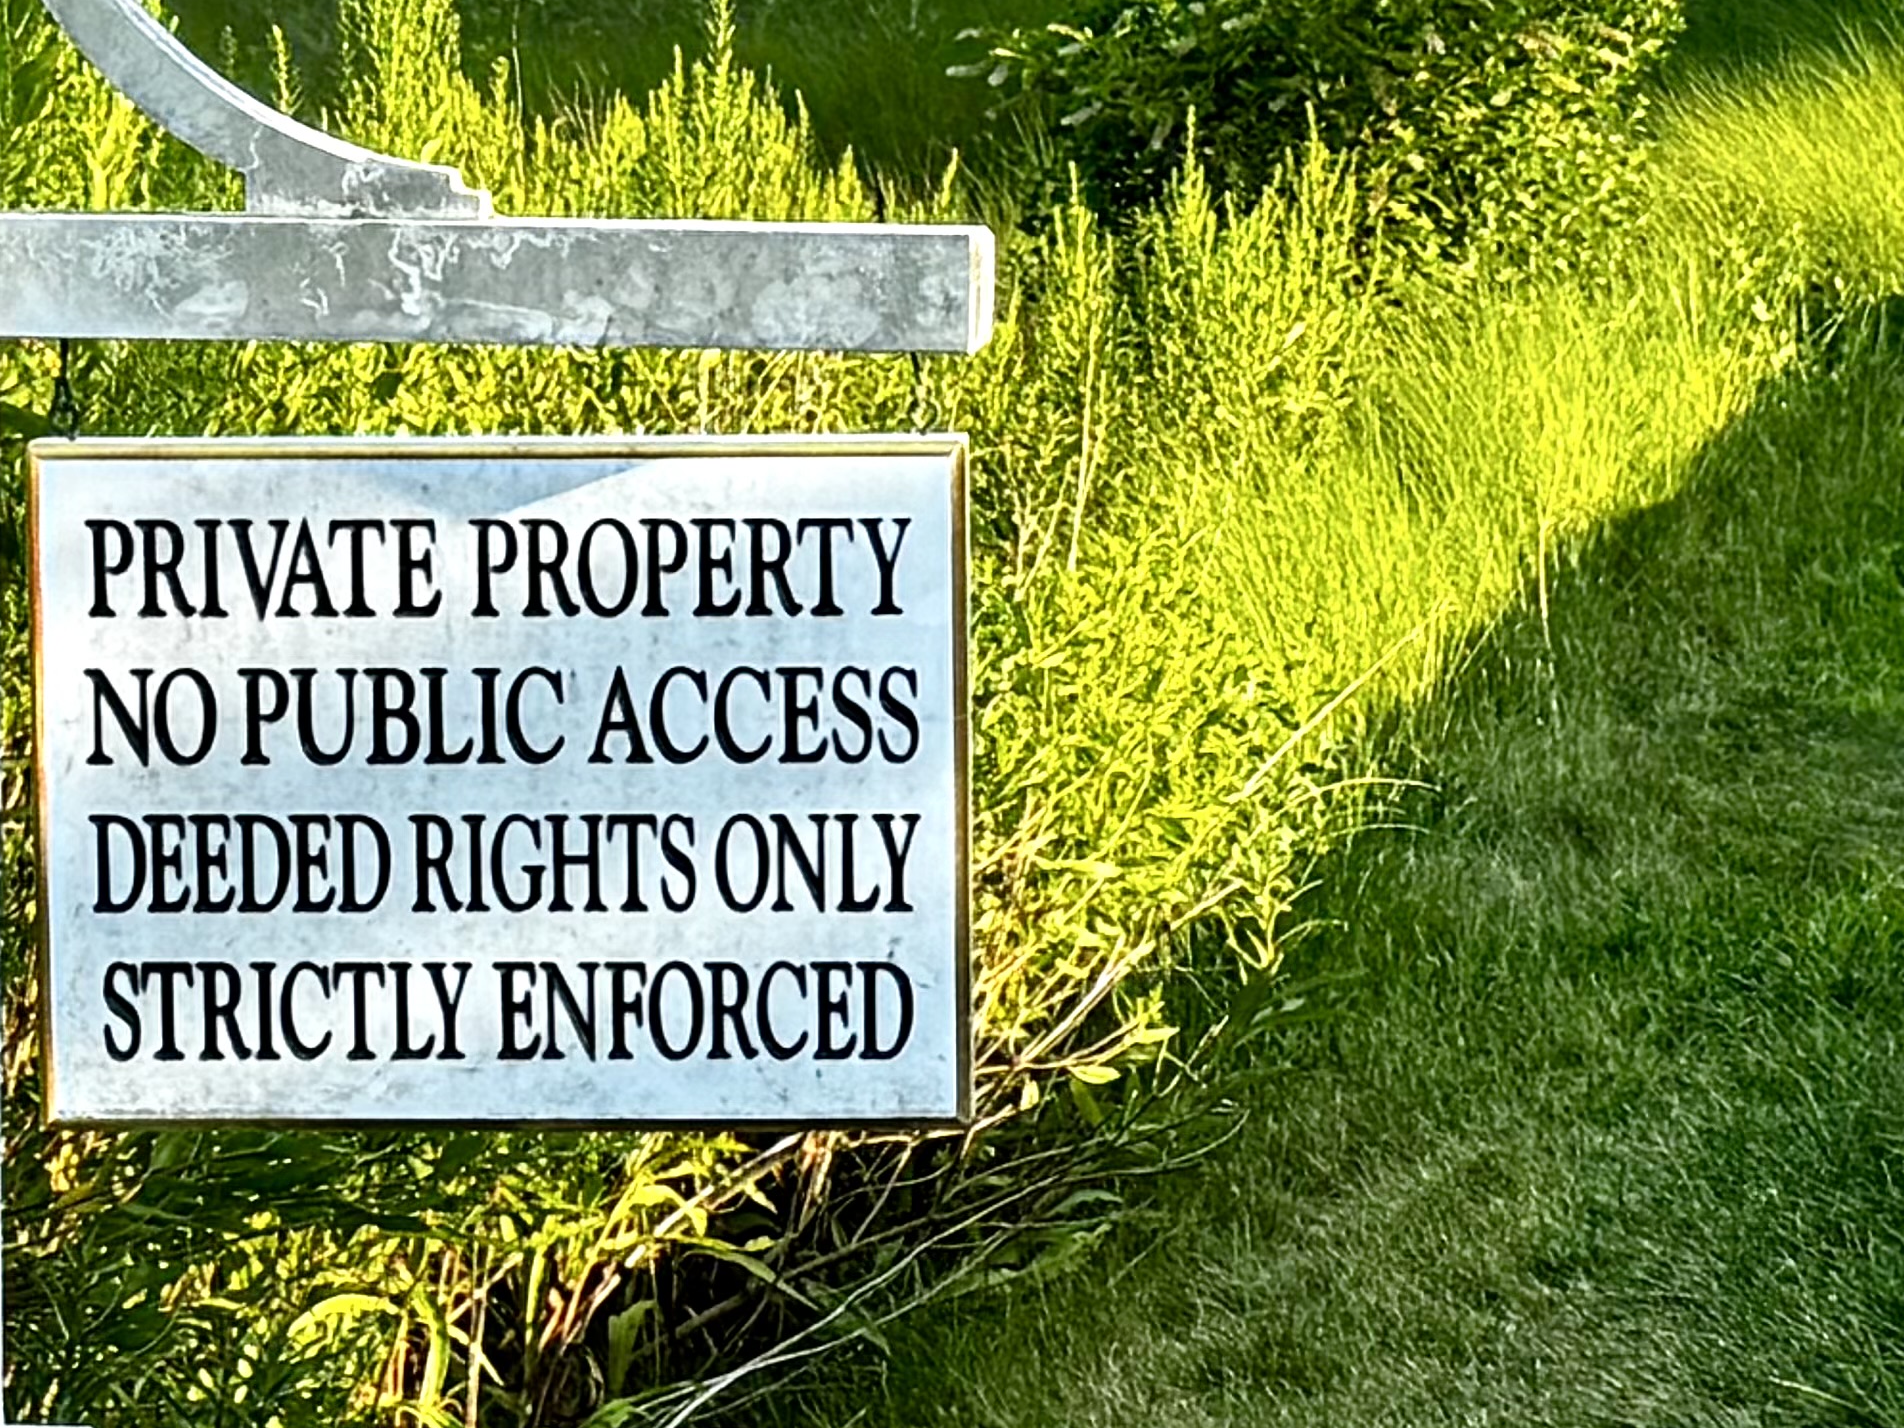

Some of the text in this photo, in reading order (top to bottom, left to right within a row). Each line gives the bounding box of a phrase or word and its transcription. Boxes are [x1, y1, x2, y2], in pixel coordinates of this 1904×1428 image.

[83, 516, 913, 622] PRIVATE PROPERTY
[82, 664, 921, 769] NO PUBLIC ACCESS
[87, 812, 922, 915] DEEDED RIGHTS ONLY
[101, 959, 915, 1063] STRICTLY ENFORCED
